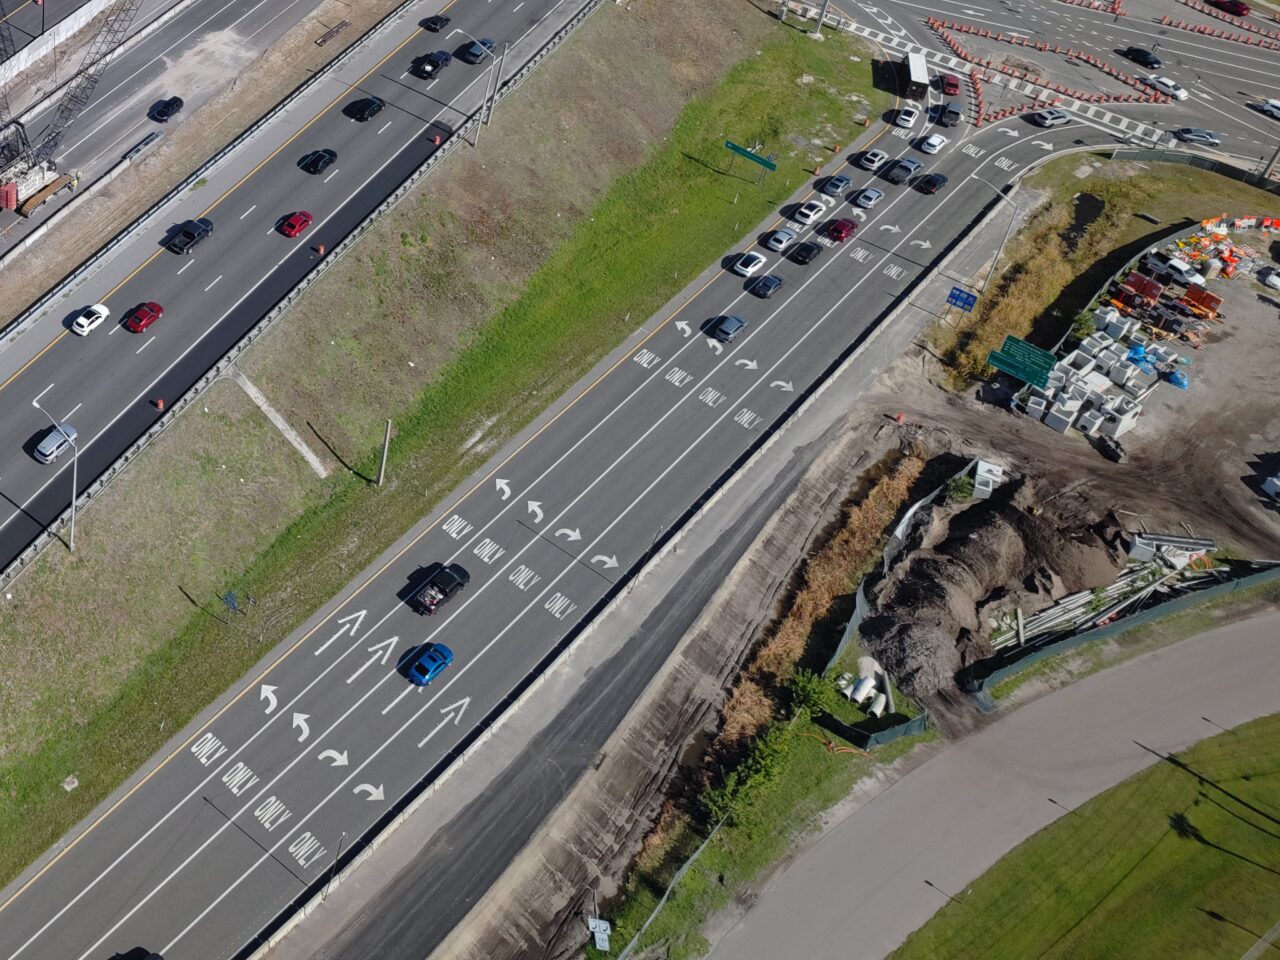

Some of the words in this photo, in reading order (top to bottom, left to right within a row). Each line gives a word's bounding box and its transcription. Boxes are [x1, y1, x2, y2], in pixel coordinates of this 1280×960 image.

[891, 127, 915, 140] ONLY
[962, 143, 987, 158] ONLY
[994, 156, 1020, 172] ONLY
[785, 220, 810, 234] ONLY
[817, 232, 840, 248] ONLY
[849, 247, 876, 264] ONLY
[882, 263, 910, 280] ONLY
[633, 349, 661, 369] ONLY
[664, 367, 694, 388] ONLY
[698, 387, 727, 408] ONLY
[733, 408, 763, 430] ONLY
[441, 514, 474, 540] ONLY
[473, 538, 506, 564] ONLY
[508, 565, 541, 592] ONLY
[543, 592, 577, 620] ONLY
[190, 732, 228, 767] ONLY
[222, 761, 260, 796] ONLY
[254, 795, 292, 831] ONLY
[288, 831, 327, 869] ONLY
